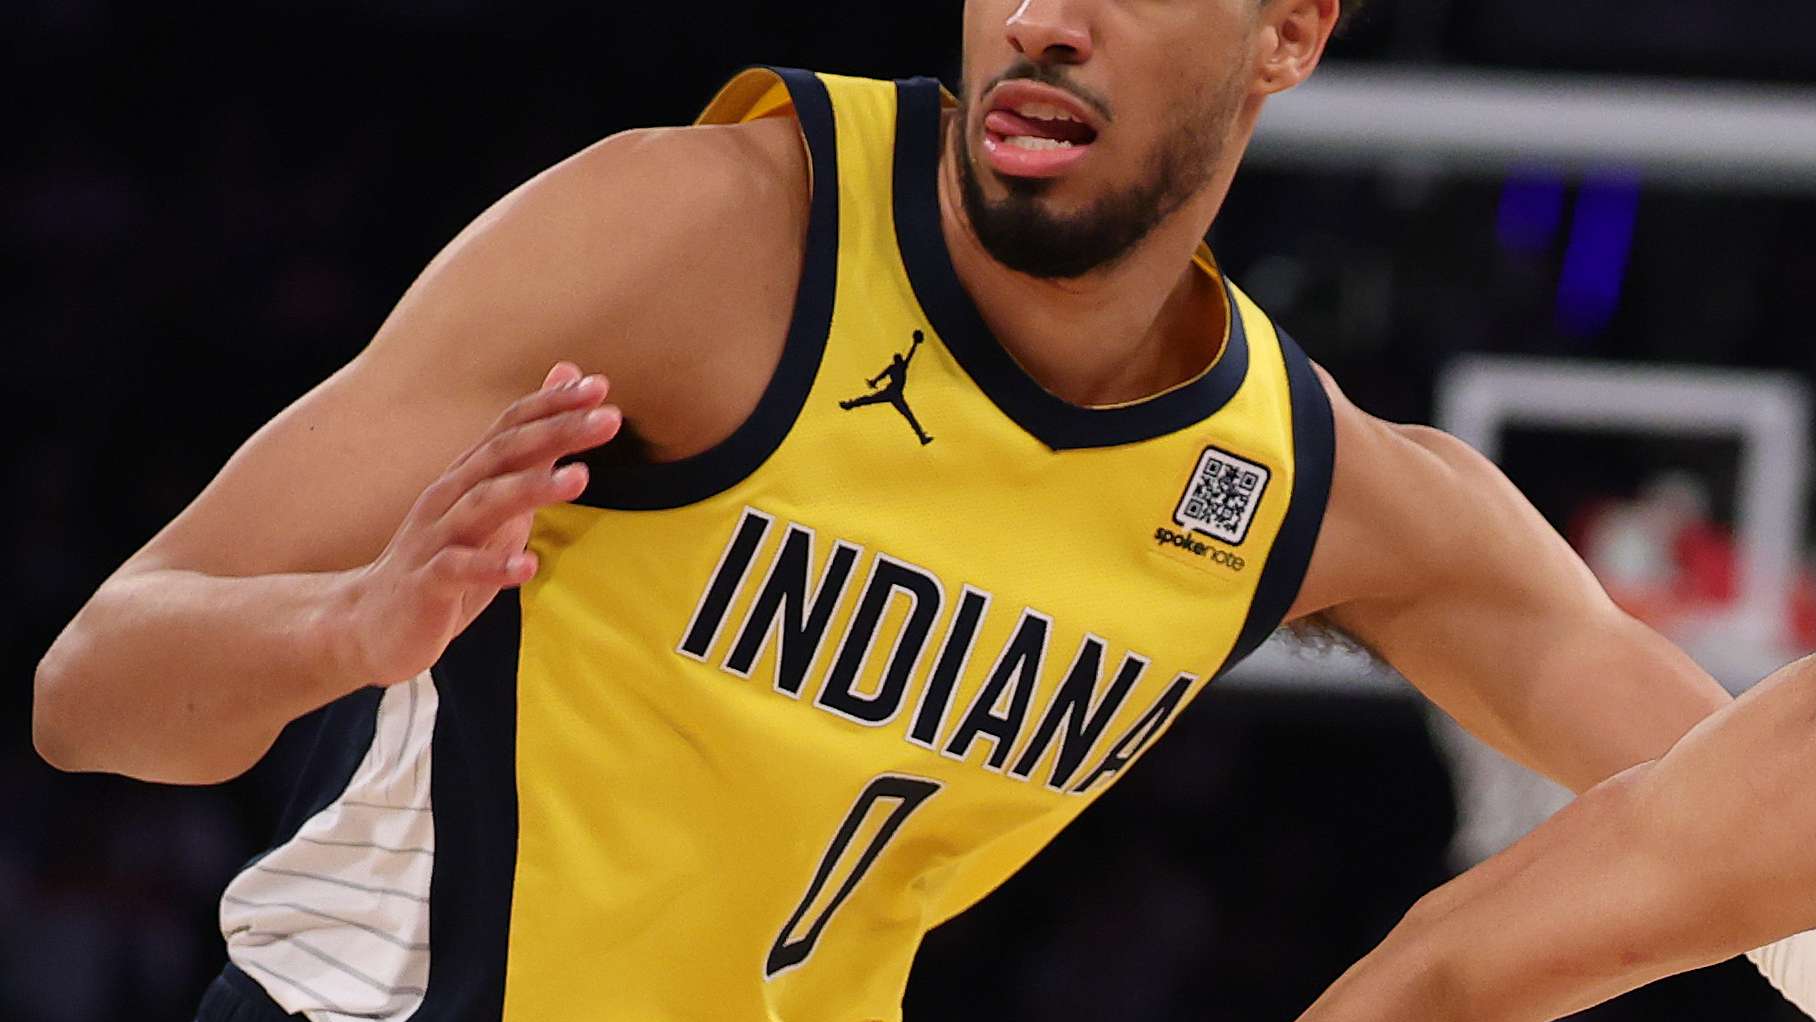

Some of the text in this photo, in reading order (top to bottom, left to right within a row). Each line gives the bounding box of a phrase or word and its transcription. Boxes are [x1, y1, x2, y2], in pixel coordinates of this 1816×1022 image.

[676, 505, 1199, 796] INDIANA
[1154, 527, 1245, 571] spokenote
[763, 771, 946, 982] 0
